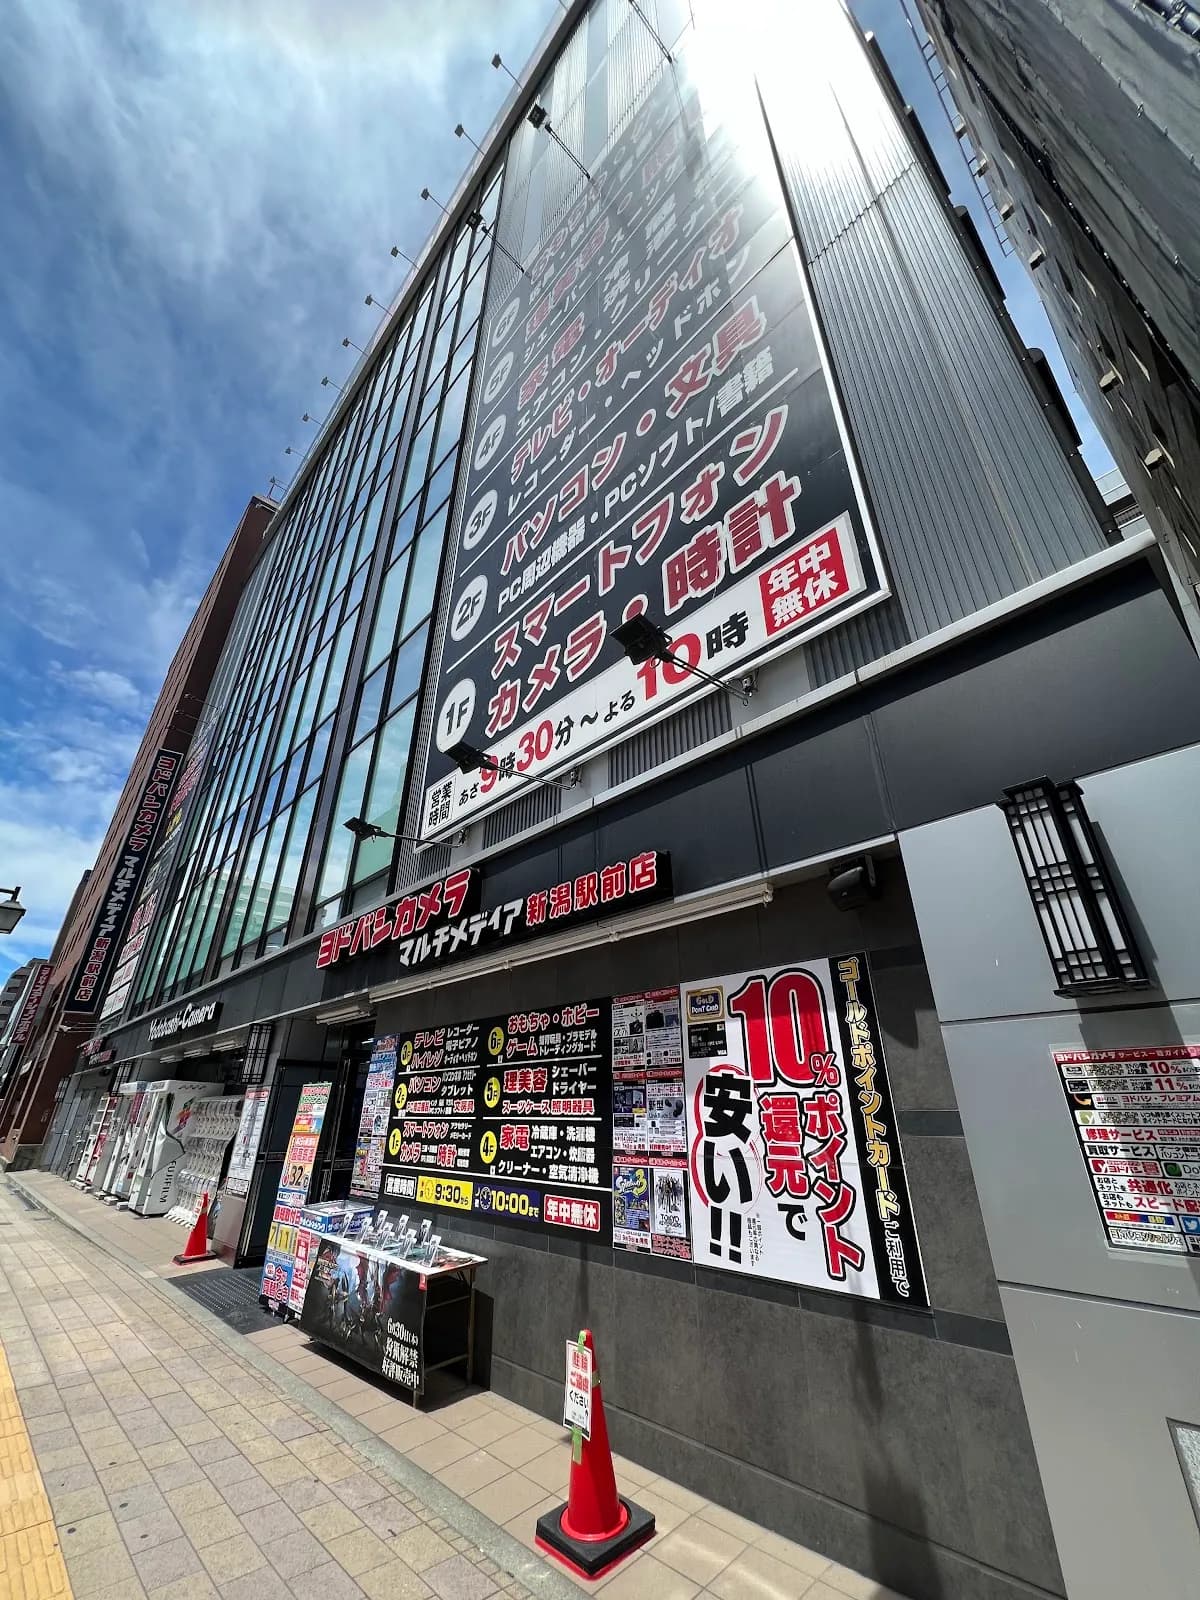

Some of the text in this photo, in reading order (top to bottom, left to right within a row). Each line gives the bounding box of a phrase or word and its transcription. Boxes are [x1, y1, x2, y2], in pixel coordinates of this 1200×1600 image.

[509, 204, 744, 487] テレビ・オーディオ
[477, 424, 505, 462] 4F
[500, 295, 767, 577] パソコン・文具
[467, 502, 494, 541] 3F
[491, 404, 788, 680] スマートフォン
[766, 541, 832, 596] 年中
[456, 586, 486, 630] 2F
[485, 469, 802, 739] カメラ・時計
[770, 574, 841, 628] 無休
[442, 692, 471, 738] 1F
[128, 756, 176, 851] ヨドバシカメラ
[431, 780, 453, 810] 営業
[428, 799, 451, 829] 時間
[316, 867, 472, 969] ヨドバシカメラ
[507, 1003, 600, 1034] おもちゃ・ホビー
[729, 968, 841, 1088] 10%
[413, 1023, 480, 1050] テレビ レコーダー
[506, 1036, 539, 1060] ゲーム
[1055, 1052, 1116, 1062] ヨドバシカメラ
[407, 1075, 442, 1095] パソコン
[440, 1083, 474, 1097] タブレット
[503, 1066, 548, 1094] 理美容
[551, 1062, 597, 1078] シェーバー
[552, 1080, 597, 1096] ドライヤー
[502, 1097, 596, 1116] スーツケース 照明器具
[402, 1120, 450, 1140] スマートフォン
[500, 1123, 531, 1152] 家電
[530, 1125, 596, 1143] 冷蔵庫・洗濯機
[1085, 1128, 1158, 1141] 修理サービス
[400, 1141, 422, 1164] カメラ
[436, 1143, 458, 1168] 時計
[530, 1144, 595, 1164] エアコン・炊飯器
[1086, 1145, 1155, 1157] 買取サービス
[159, 1160, 177, 1203] FUJIFILM
[498, 1159, 600, 1185] クリーナー・空気清浄機
[803, 1091, 864, 1279] ポイント
[1127, 1178, 1174, 1195] 共通化
[546, 1198, 598, 1228] 年中無休
[569, 1389, 589, 1409] ください
